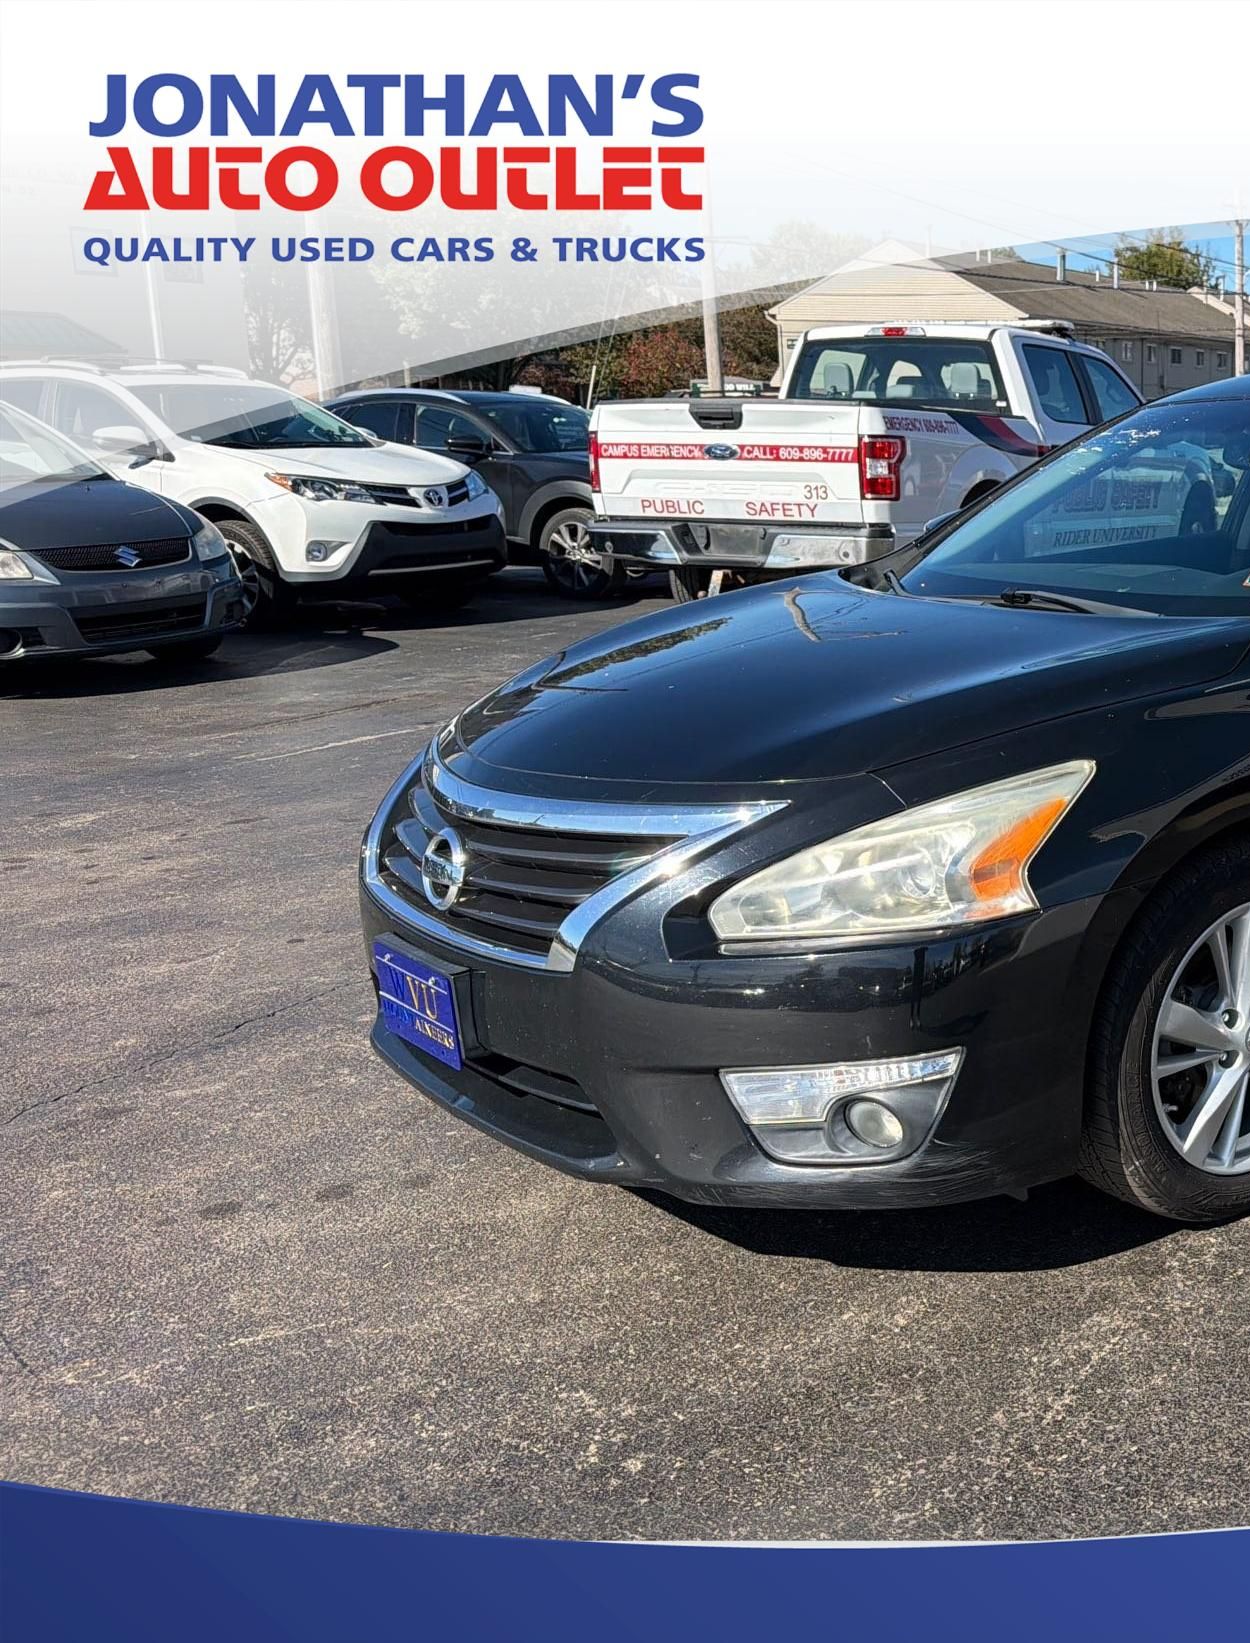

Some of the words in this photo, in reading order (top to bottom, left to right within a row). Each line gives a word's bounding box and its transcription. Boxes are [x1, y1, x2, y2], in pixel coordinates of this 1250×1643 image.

[601, 444, 639, 457] CAMPUS
[779, 448, 854, 461] 609-896-7777
[803, 484, 829, 501] 313
[641, 499, 705, 515] PUBLIC
[745, 501, 818, 518] SAFETY
[1054, 529, 1090, 547] RIDER
[1091, 525, 1158, 545] UNIVERSITY
